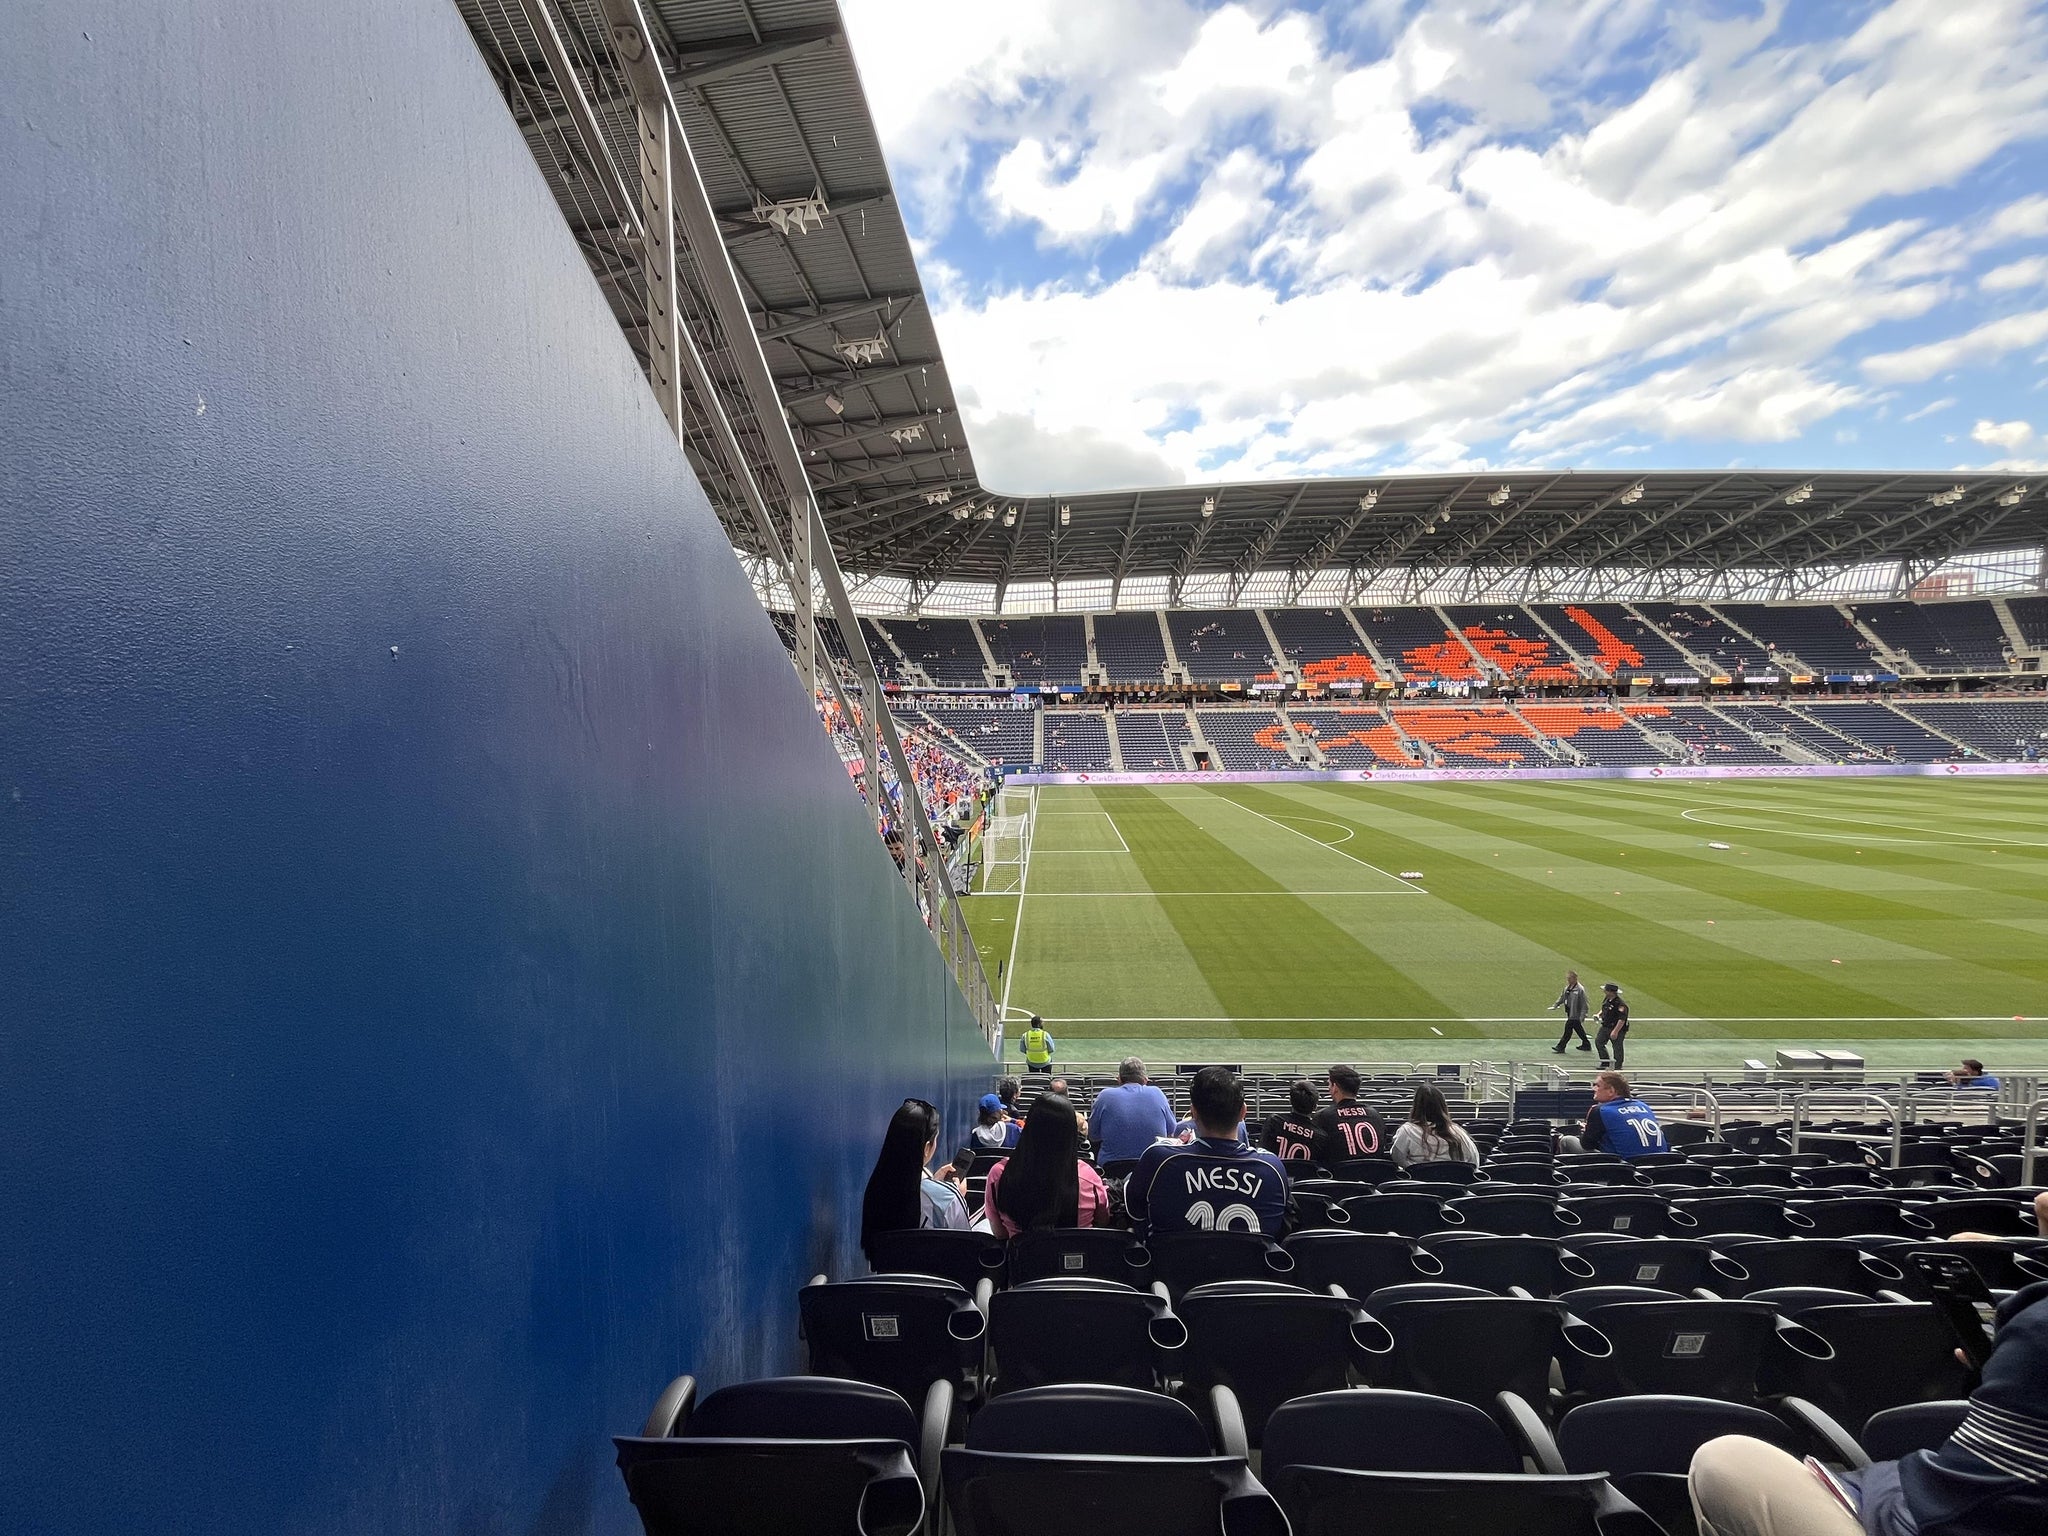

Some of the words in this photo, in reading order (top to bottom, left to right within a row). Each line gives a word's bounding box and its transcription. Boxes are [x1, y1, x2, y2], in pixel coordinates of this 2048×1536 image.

[1337, 1106, 1367, 1117] MESSI
[1283, 1120, 1314, 1139] MESSI
[1337, 1120, 1379, 1156] 10
[1626, 1117, 1663, 1147] 19
[1184, 1166, 1263, 1200] MESSI
